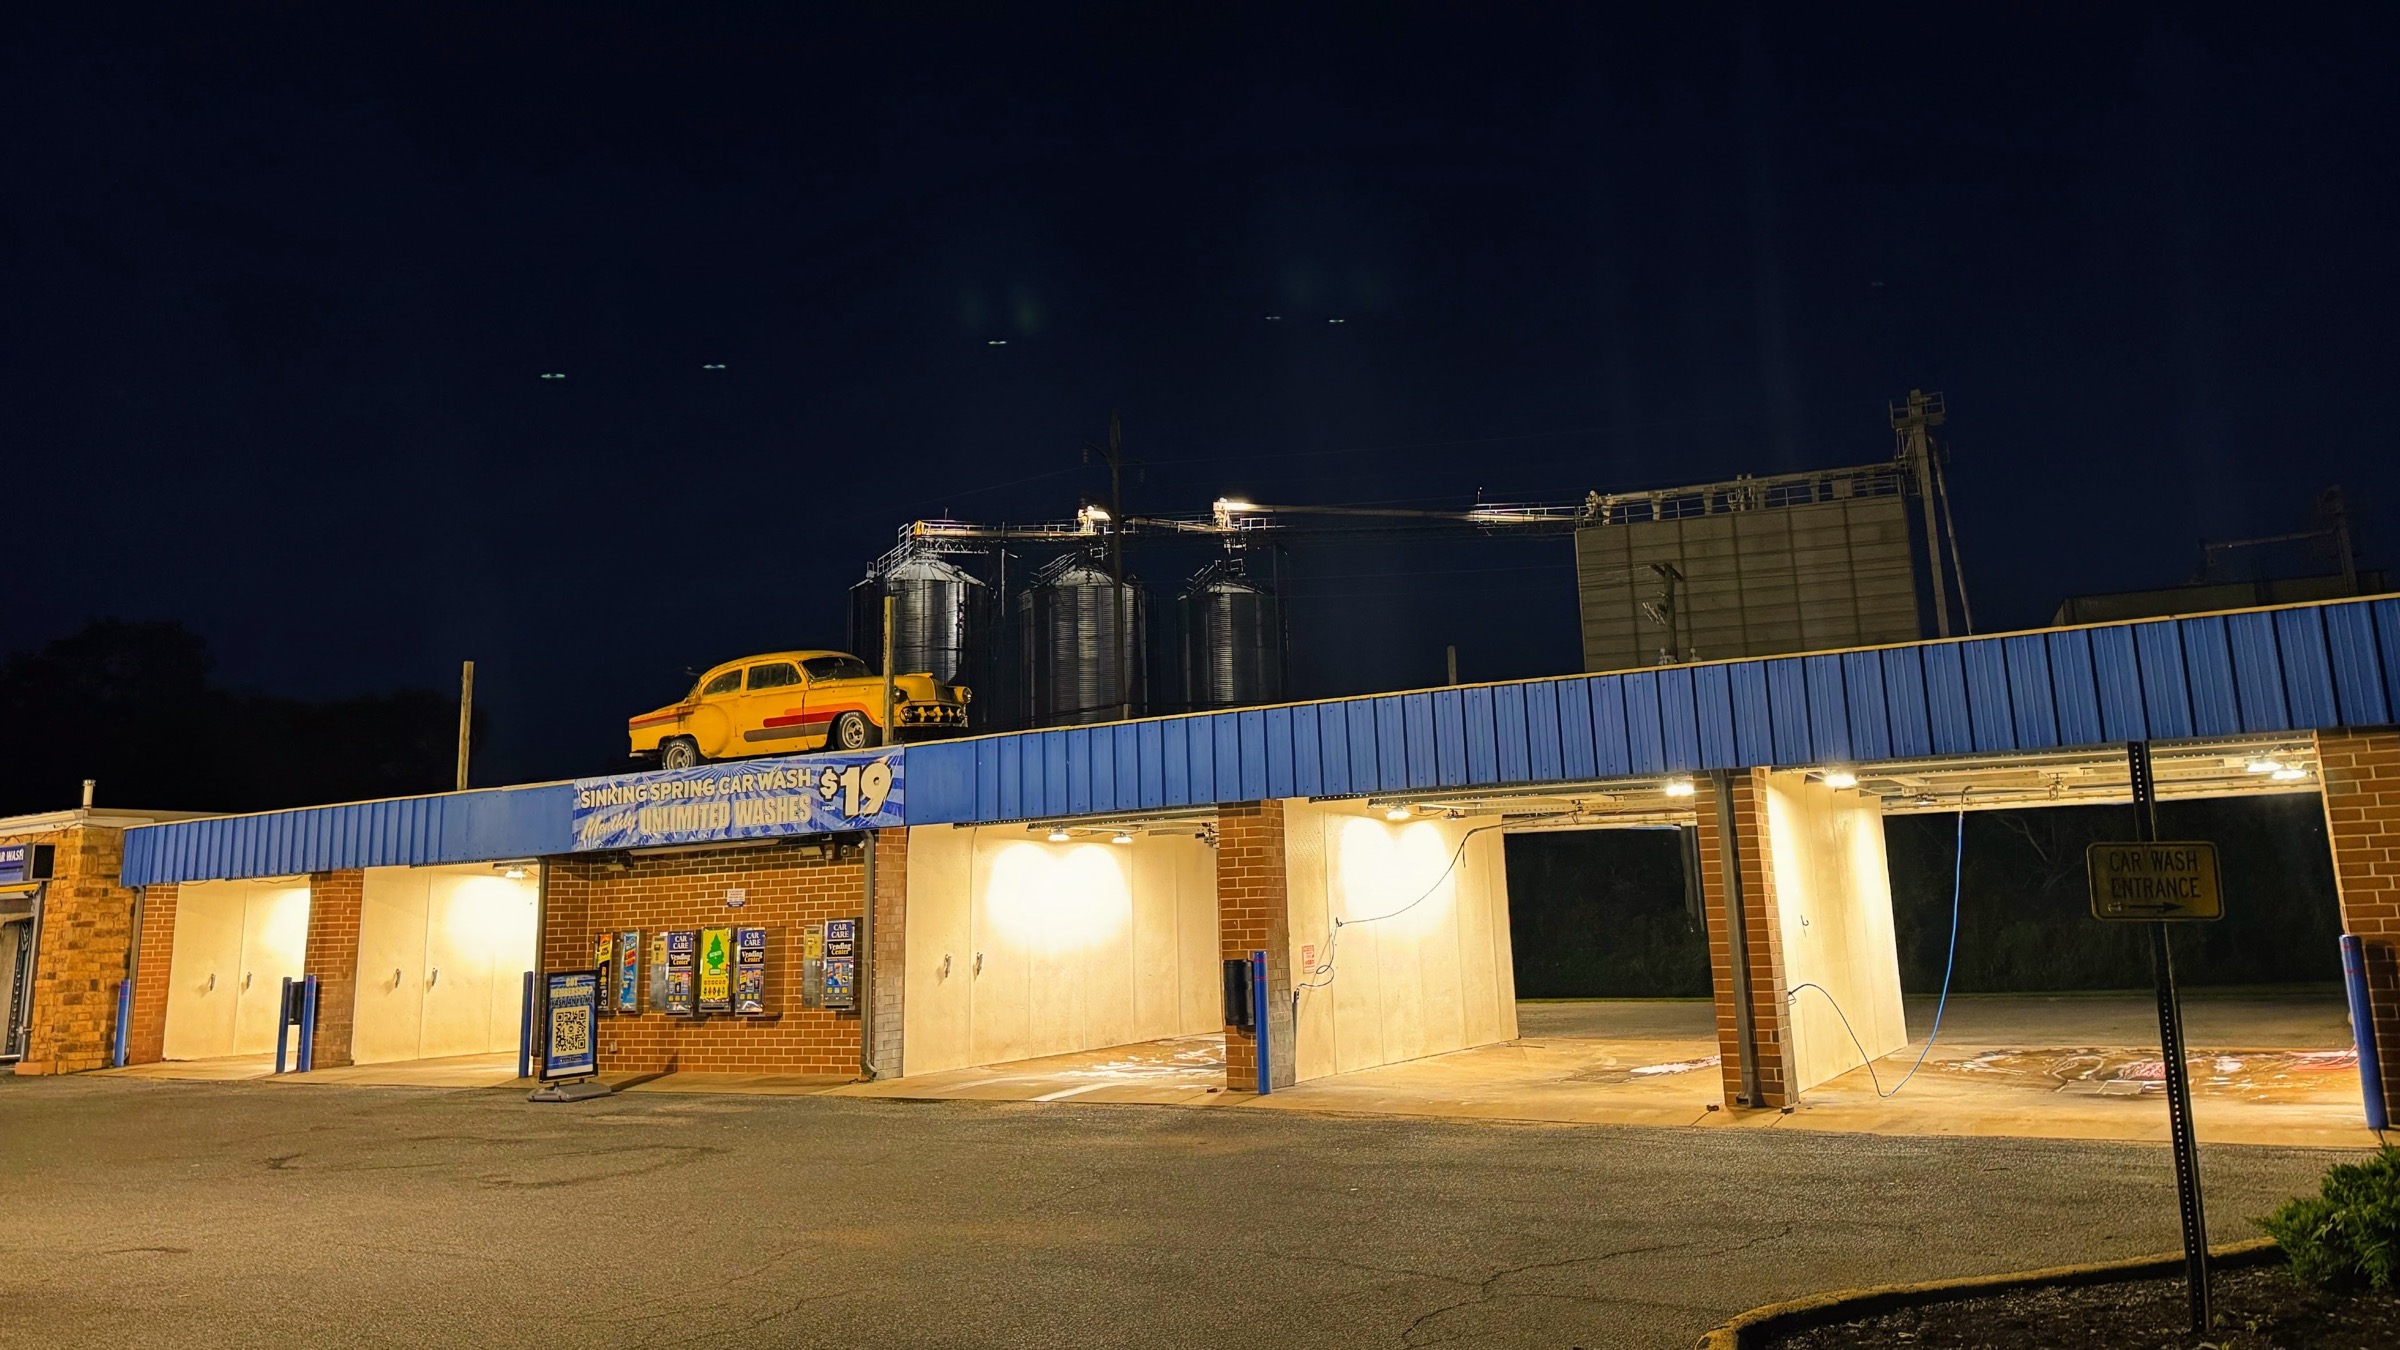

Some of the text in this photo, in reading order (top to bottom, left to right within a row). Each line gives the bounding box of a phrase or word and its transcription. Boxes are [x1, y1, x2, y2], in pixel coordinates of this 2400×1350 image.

[580, 767, 812, 809] SINKING SPRING CAR WASH
[819, 762, 892, 818] $19
[580, 793, 812, 841] Monthly UNLIMITED WASHES
[6, 848, 24, 862] WASH
[2109, 849, 2199, 872] CAR WASH
[2110, 877, 2202, 898] ENTRANCE
[833, 923, 847, 931] CAR
[746, 932, 760, 940] CAR
[831, 930, 849, 939] CARE
[674, 935, 688, 943] CAR
[744, 939, 761, 947] CARE
[672, 942, 689, 950] CARE
[828, 942, 852, 951] Vending
[741, 950, 763, 958] Vending
[830, 948, 849, 956] Center
[670, 953, 691, 961] Vending
